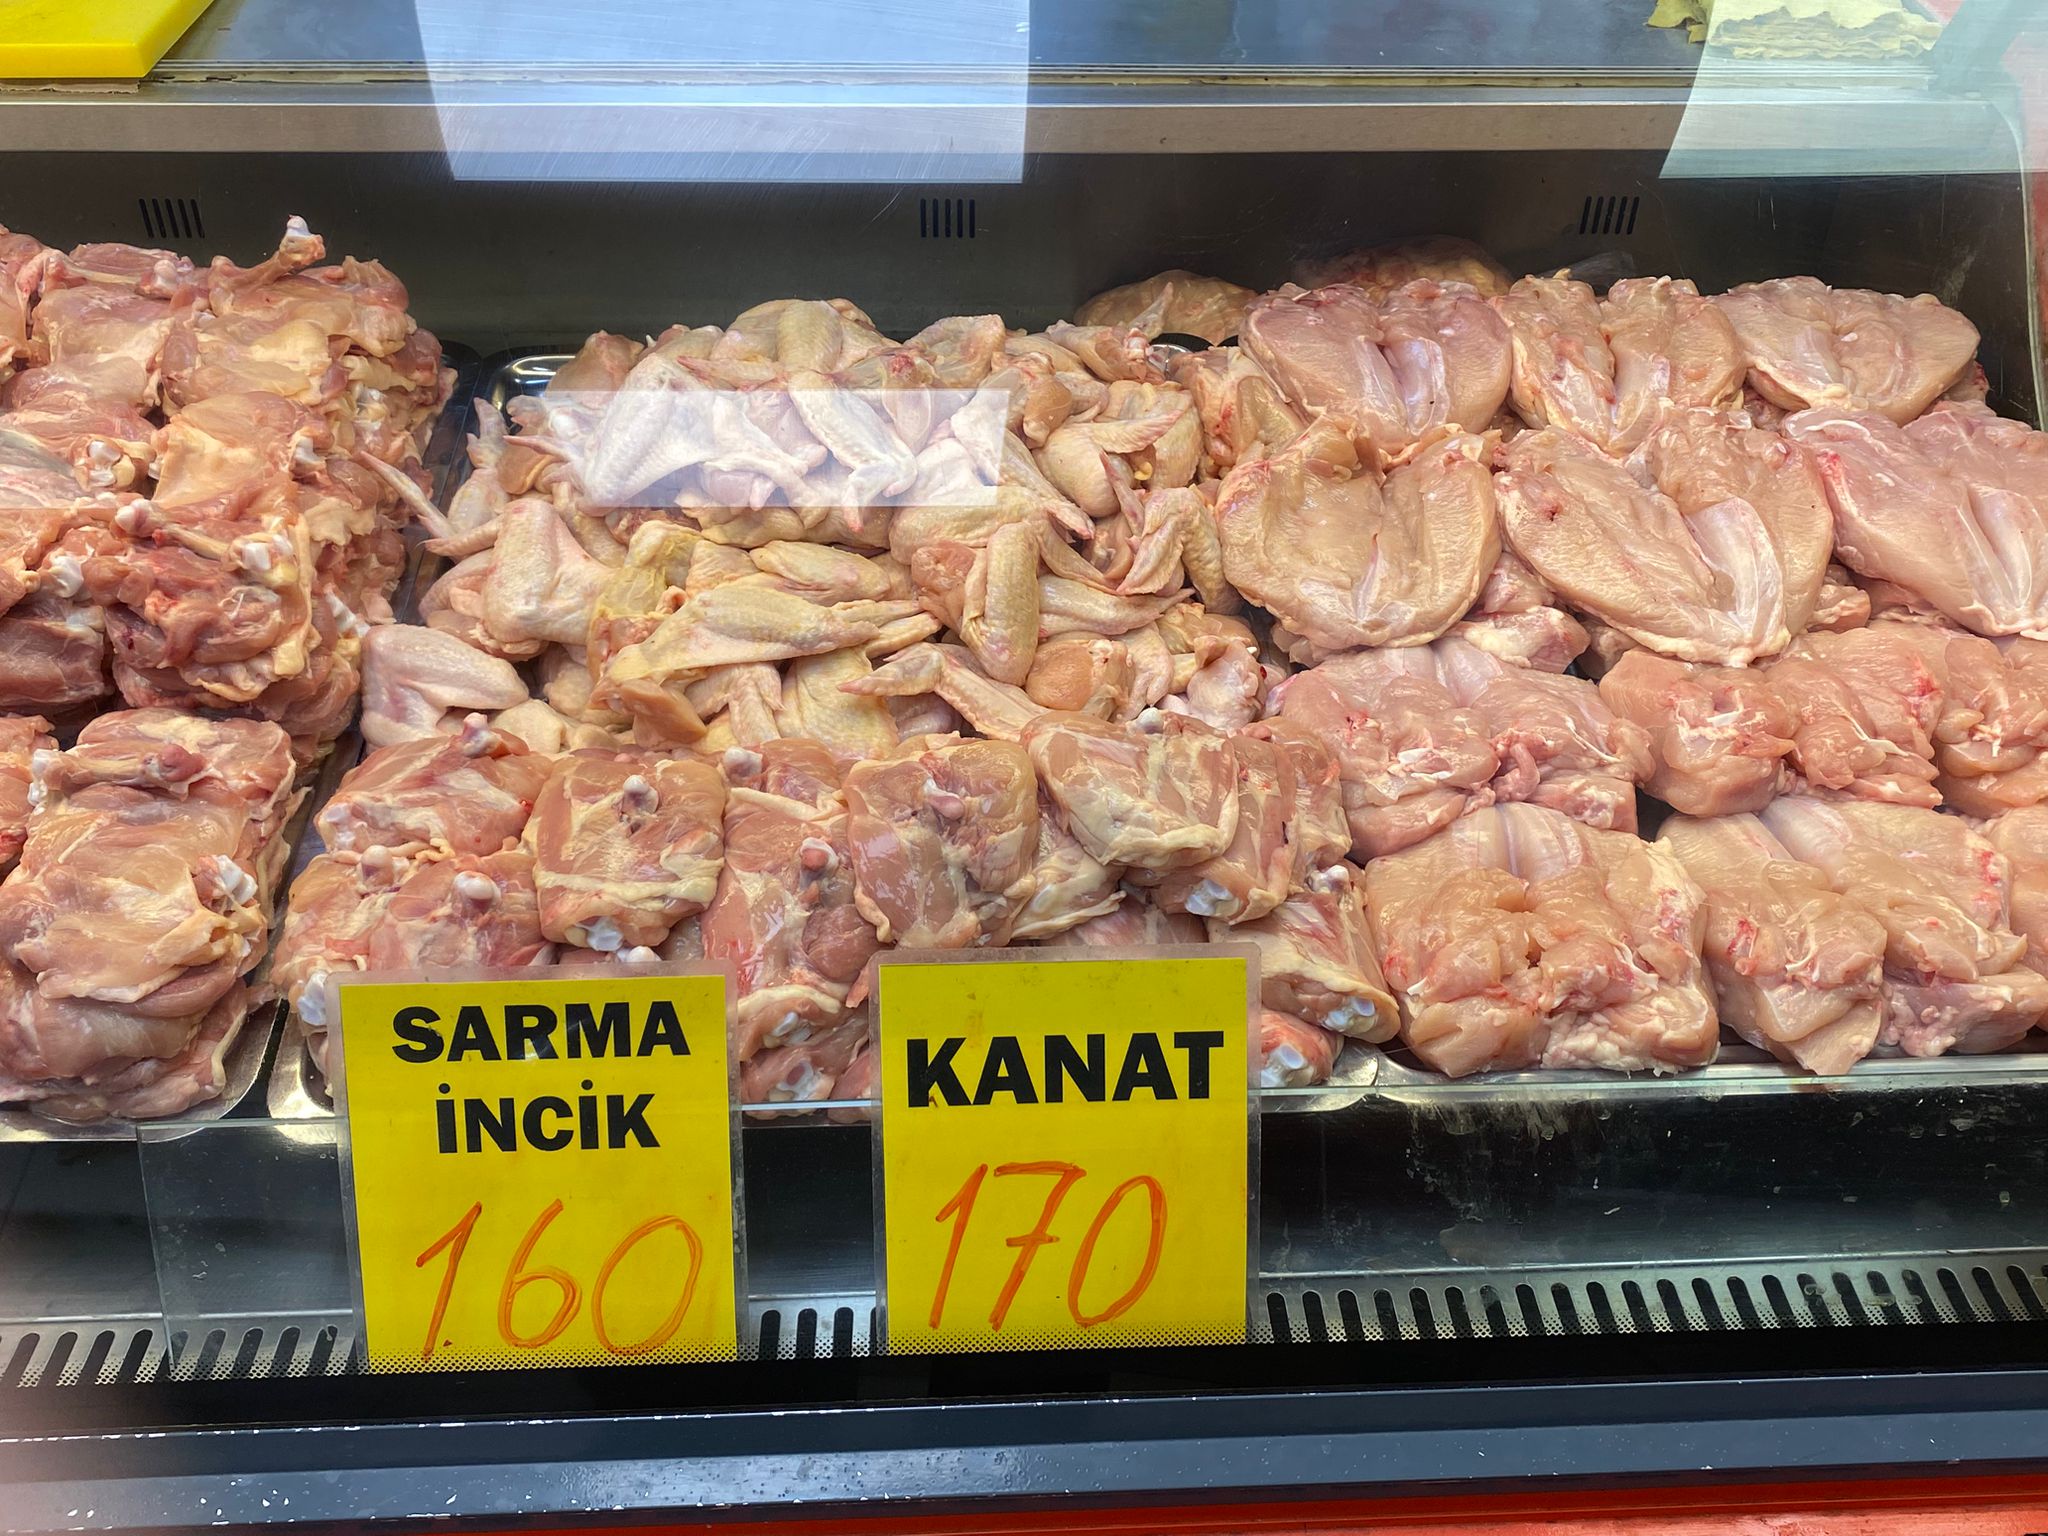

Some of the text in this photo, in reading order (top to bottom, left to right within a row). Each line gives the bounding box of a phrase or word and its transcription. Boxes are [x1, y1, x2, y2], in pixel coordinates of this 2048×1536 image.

[392, 1001, 690, 1063] SARMA
[907, 1031, 1224, 1107] KANAT
[436, 1080, 660, 1153] İNCİK
[416, 1200, 702, 1361] 160
[930, 1161, 1167, 1332] 170
